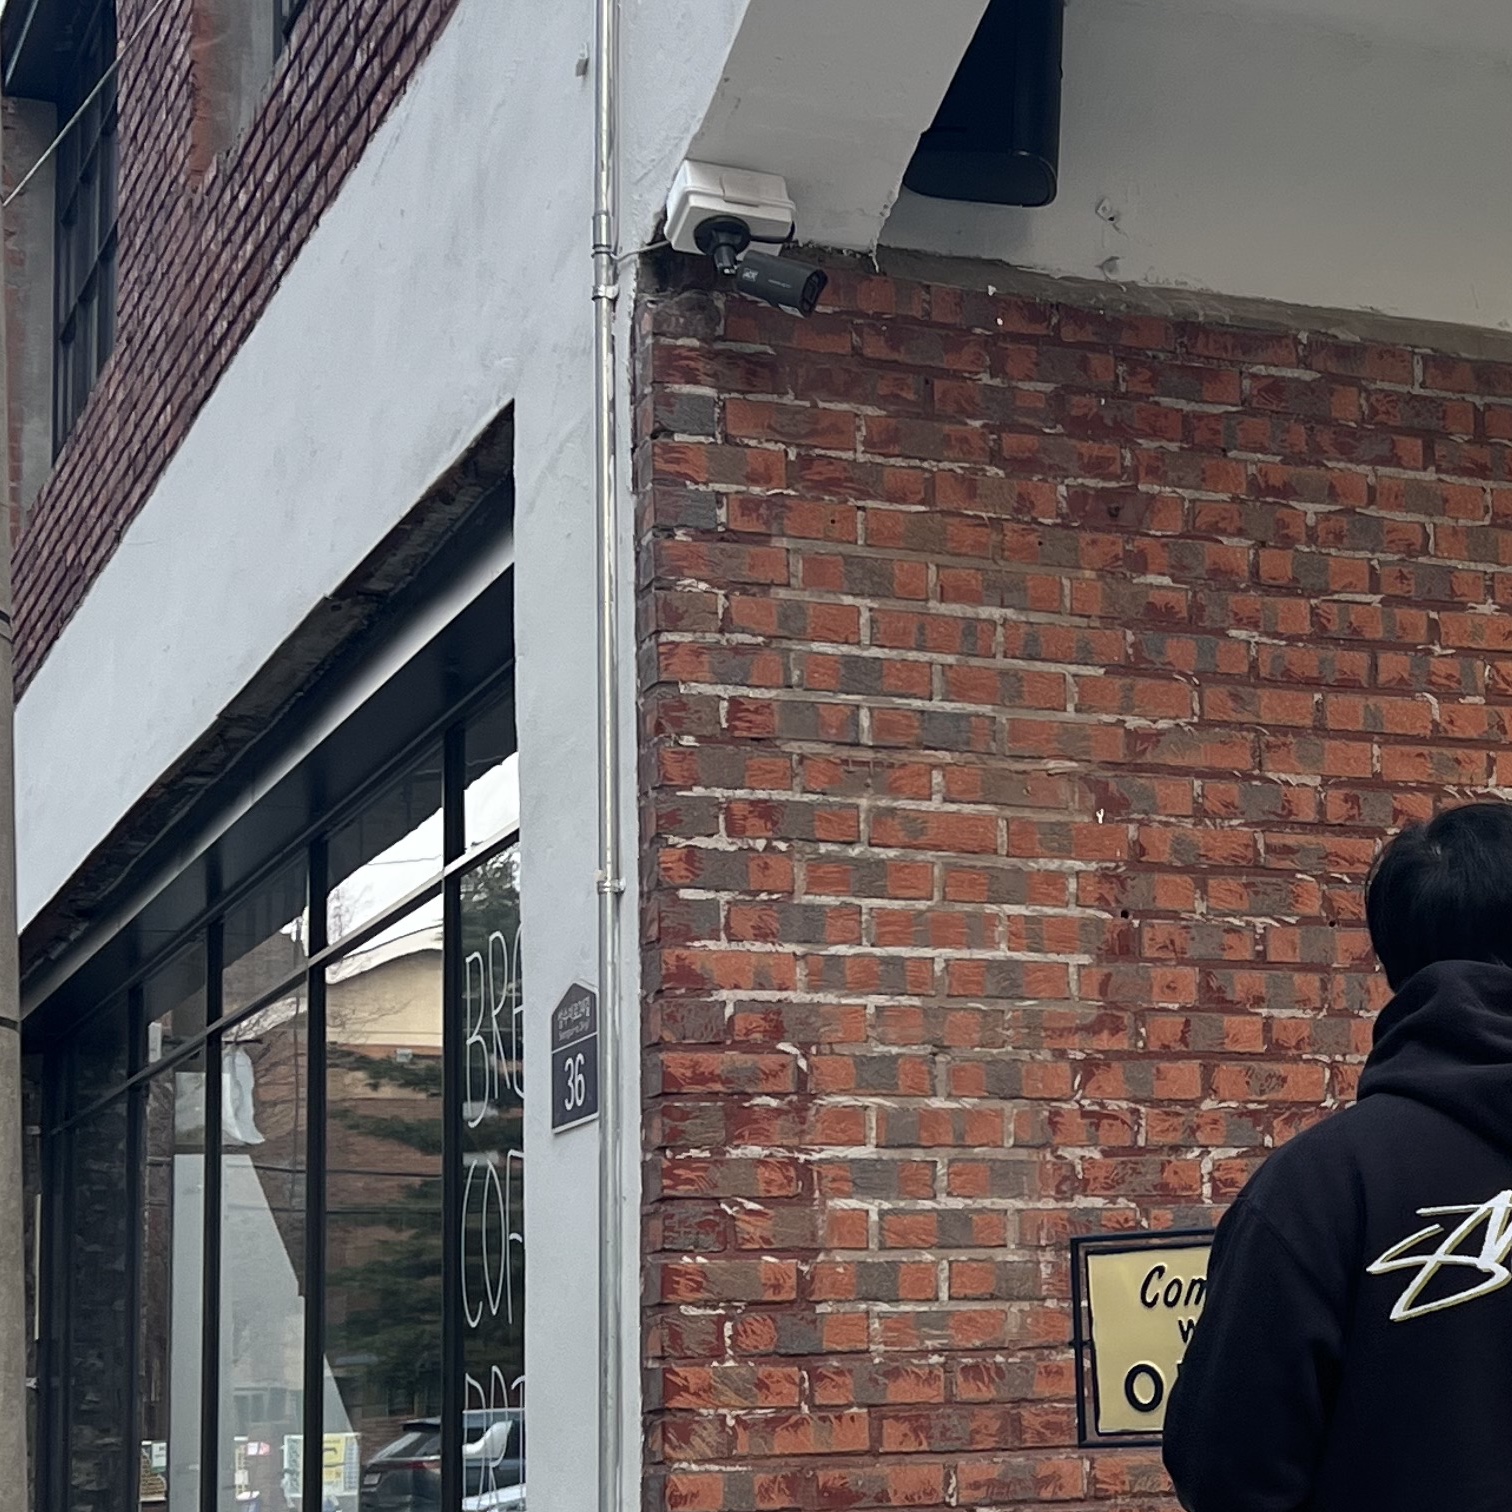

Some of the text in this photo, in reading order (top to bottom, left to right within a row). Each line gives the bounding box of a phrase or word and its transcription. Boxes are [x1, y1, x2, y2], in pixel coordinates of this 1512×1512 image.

[564, 1053, 585, 1111] 36
[461, 1149, 524, 1328] COF
[1140, 1264, 1207, 1308] Com
